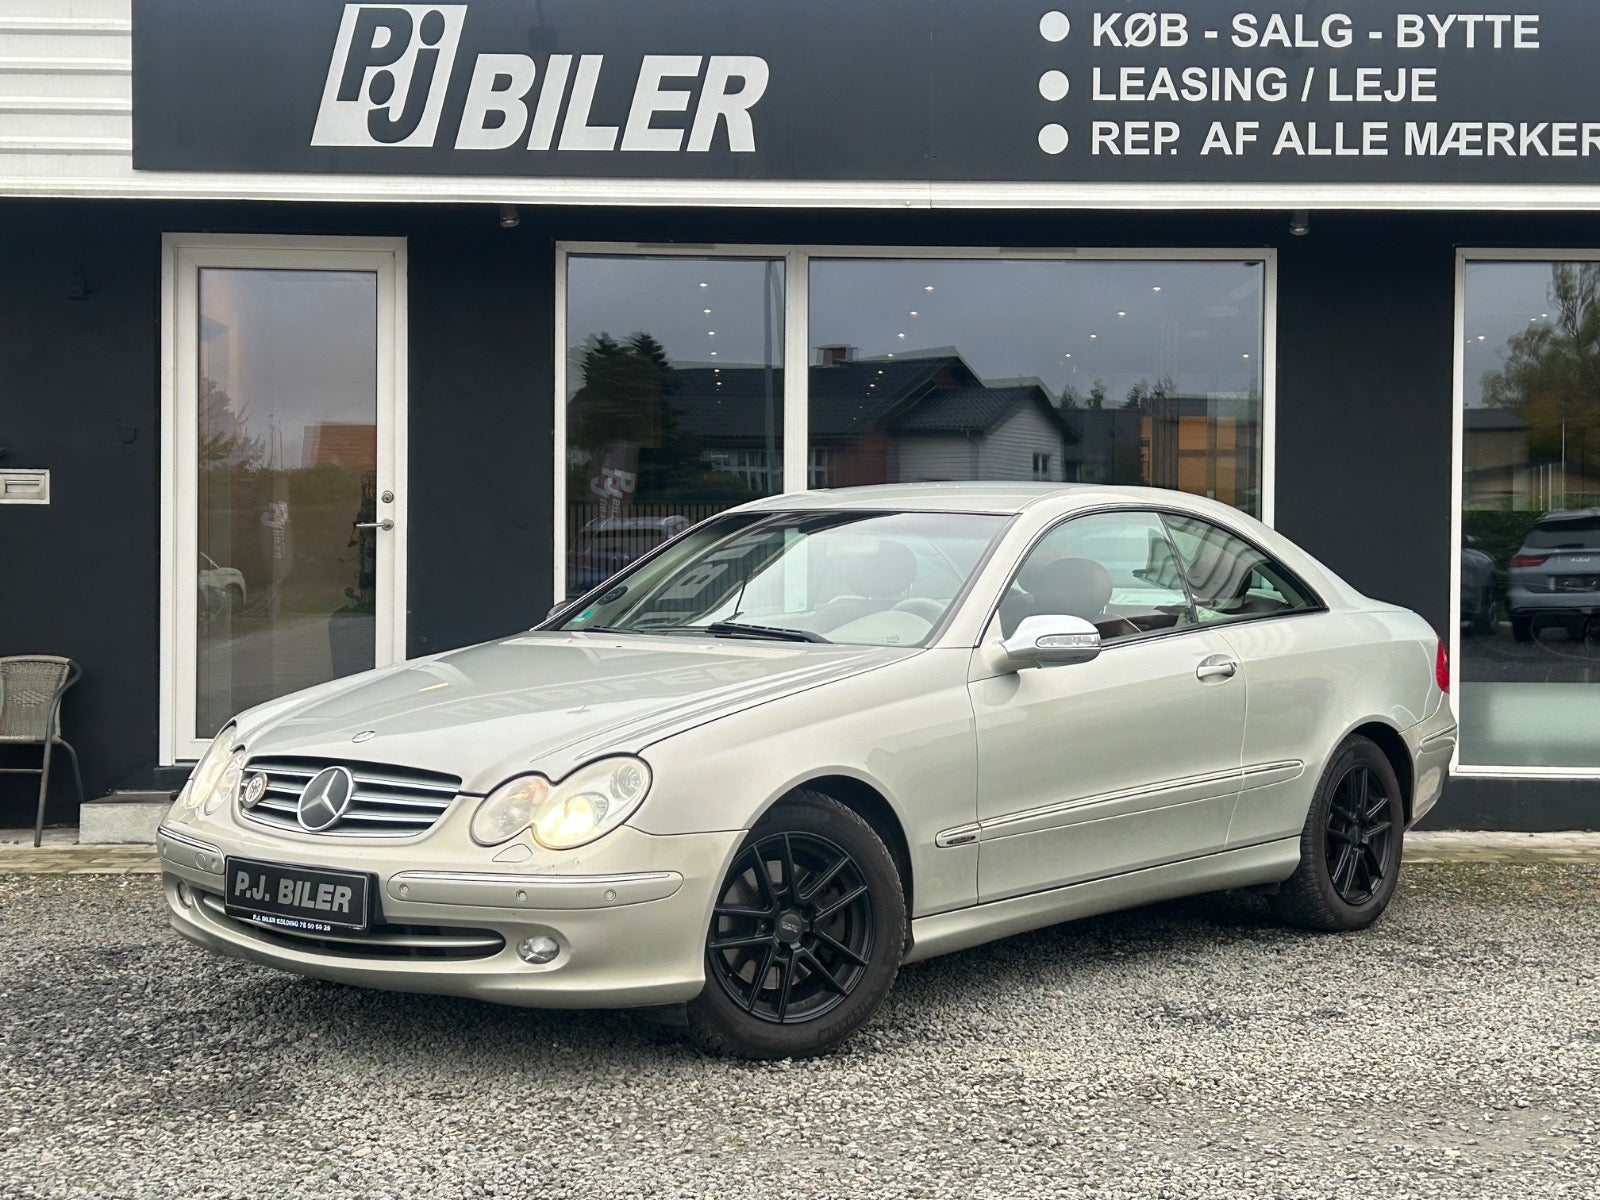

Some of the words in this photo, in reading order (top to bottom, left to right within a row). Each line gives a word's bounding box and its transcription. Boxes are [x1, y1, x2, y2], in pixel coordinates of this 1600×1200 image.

[1093, 12, 1189, 48] KØB
[1231, 13, 1353, 48] SALG
[1396, 13, 1540, 49] BYTTE
[1092, 66, 1287, 102] LEASING
[1328, 67, 1437, 102] LEJE
[454, 53, 770, 153] BILER
[1091, 121, 1181, 156] REP.
[1199, 121, 1260, 156] AF
[1272, 121, 1389, 156] ALLE
[234, 870, 271, 902] P.J.
[277, 877, 353, 914] BILER
